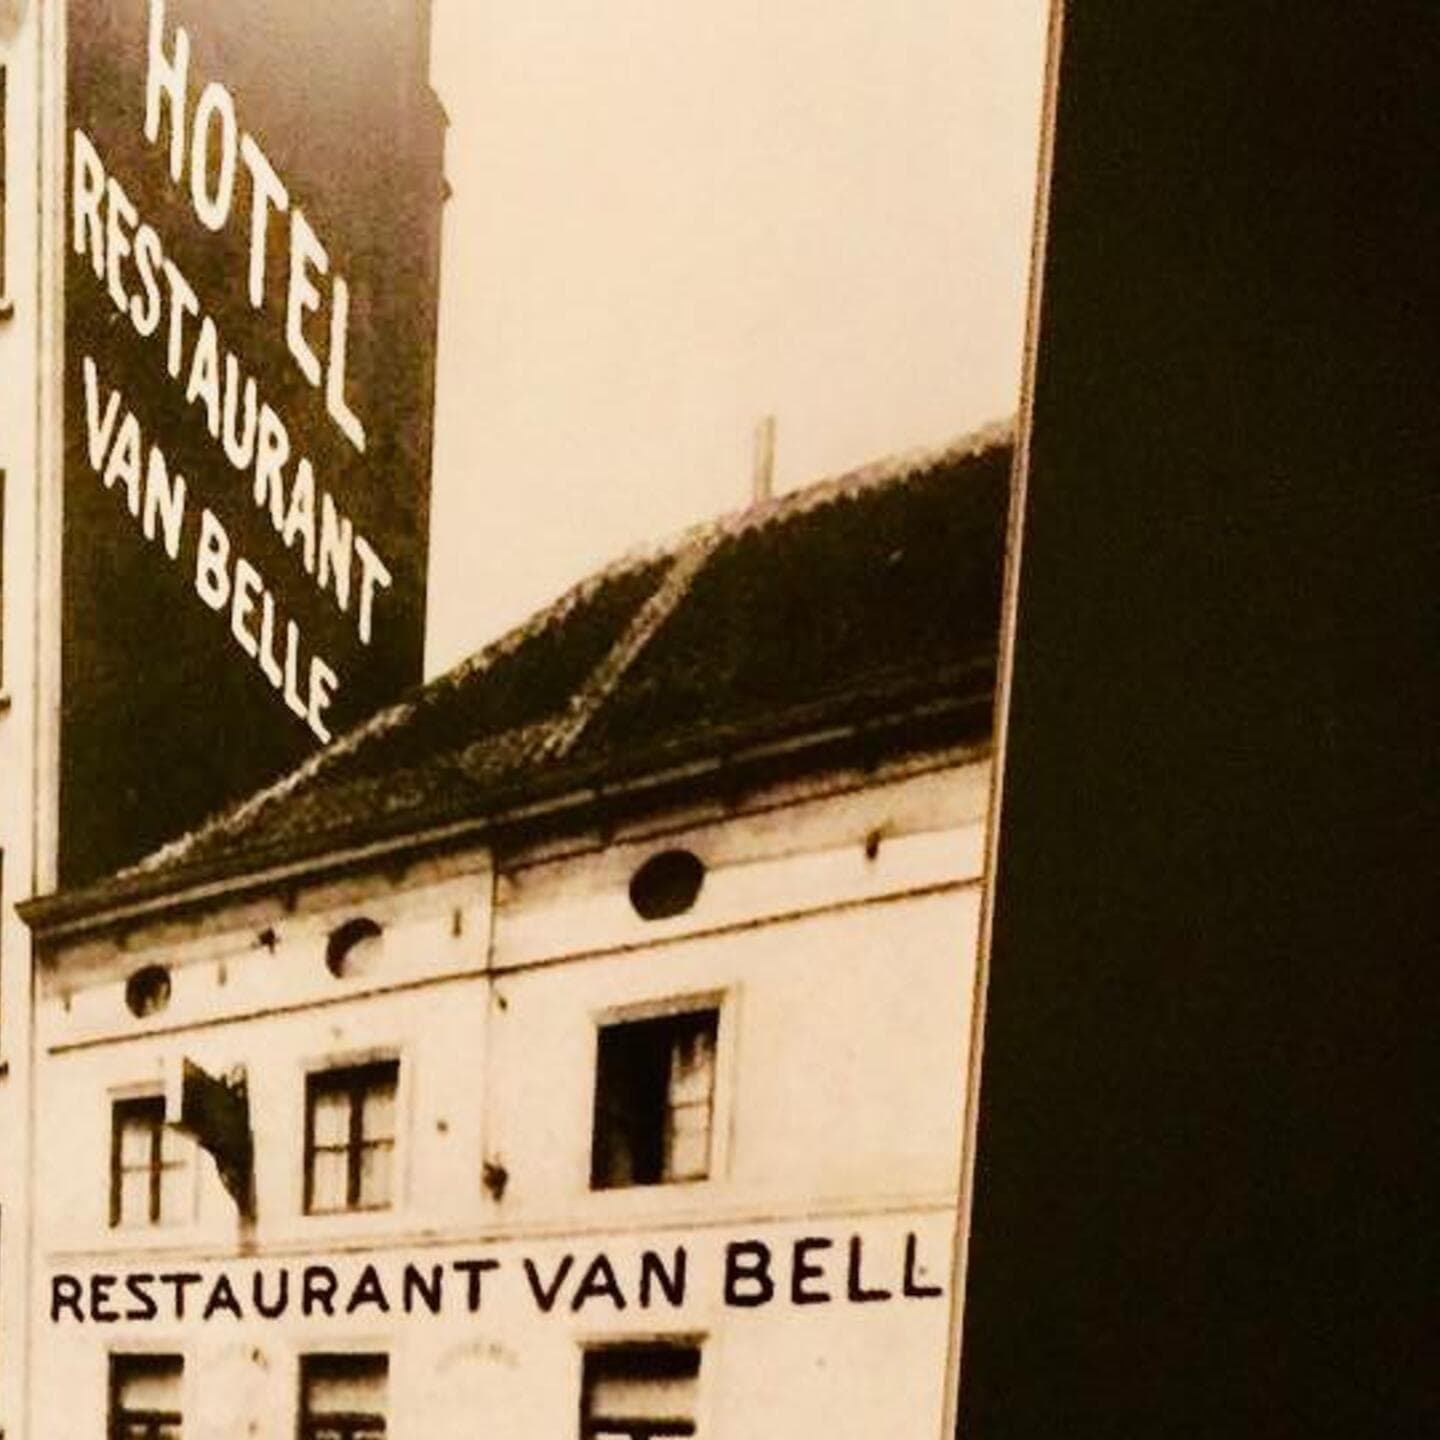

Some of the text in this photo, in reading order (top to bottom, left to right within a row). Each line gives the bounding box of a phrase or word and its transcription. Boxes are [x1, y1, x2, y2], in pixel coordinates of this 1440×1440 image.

[73, 128, 392, 645] RESTAURANT
[144, 0, 365, 453] HOTEL
[83, 356, 339, 744] VAN BELLE
[50, 1232, 943, 1323] RESTAURANT VAN BELL
